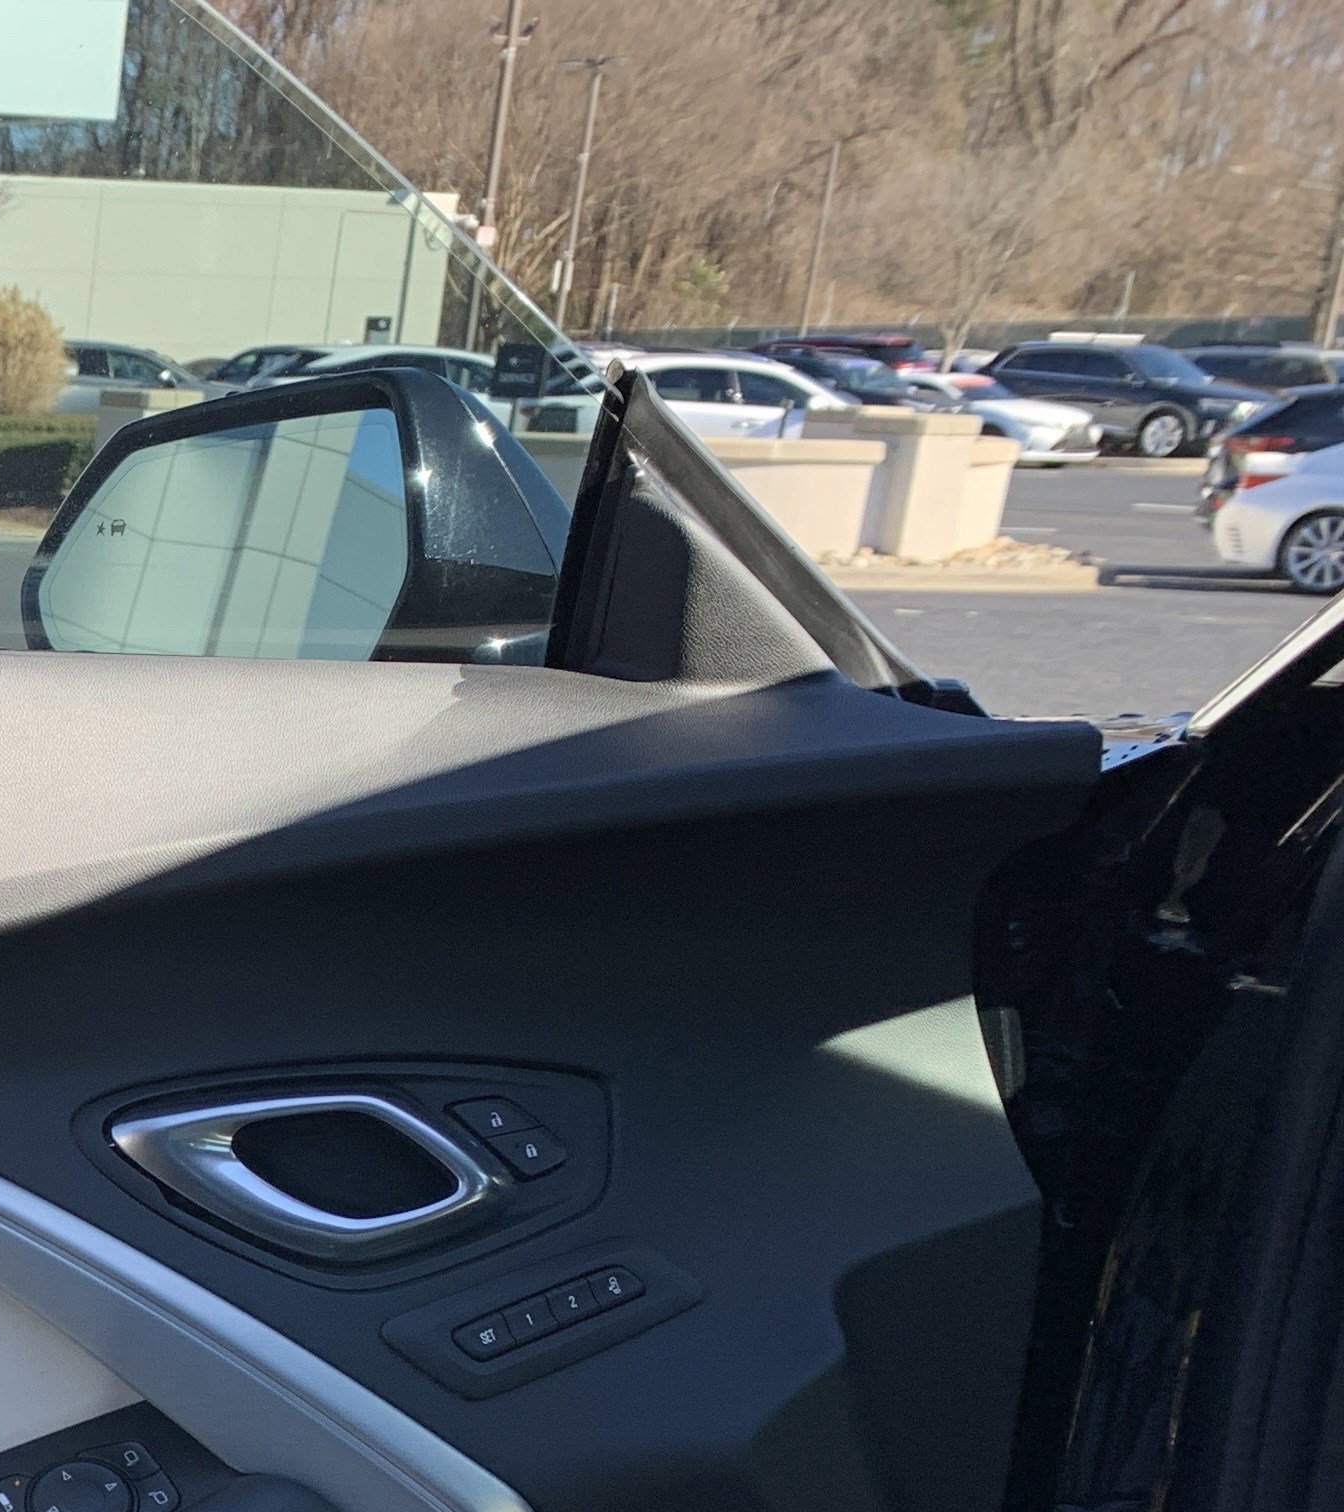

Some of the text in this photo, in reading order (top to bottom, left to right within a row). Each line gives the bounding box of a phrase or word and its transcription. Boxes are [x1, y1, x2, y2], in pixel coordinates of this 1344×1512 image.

[568, 1295, 579, 1309] 2
[525, 1313, 534, 1326] 1
[479, 1328, 497, 1345] SET
